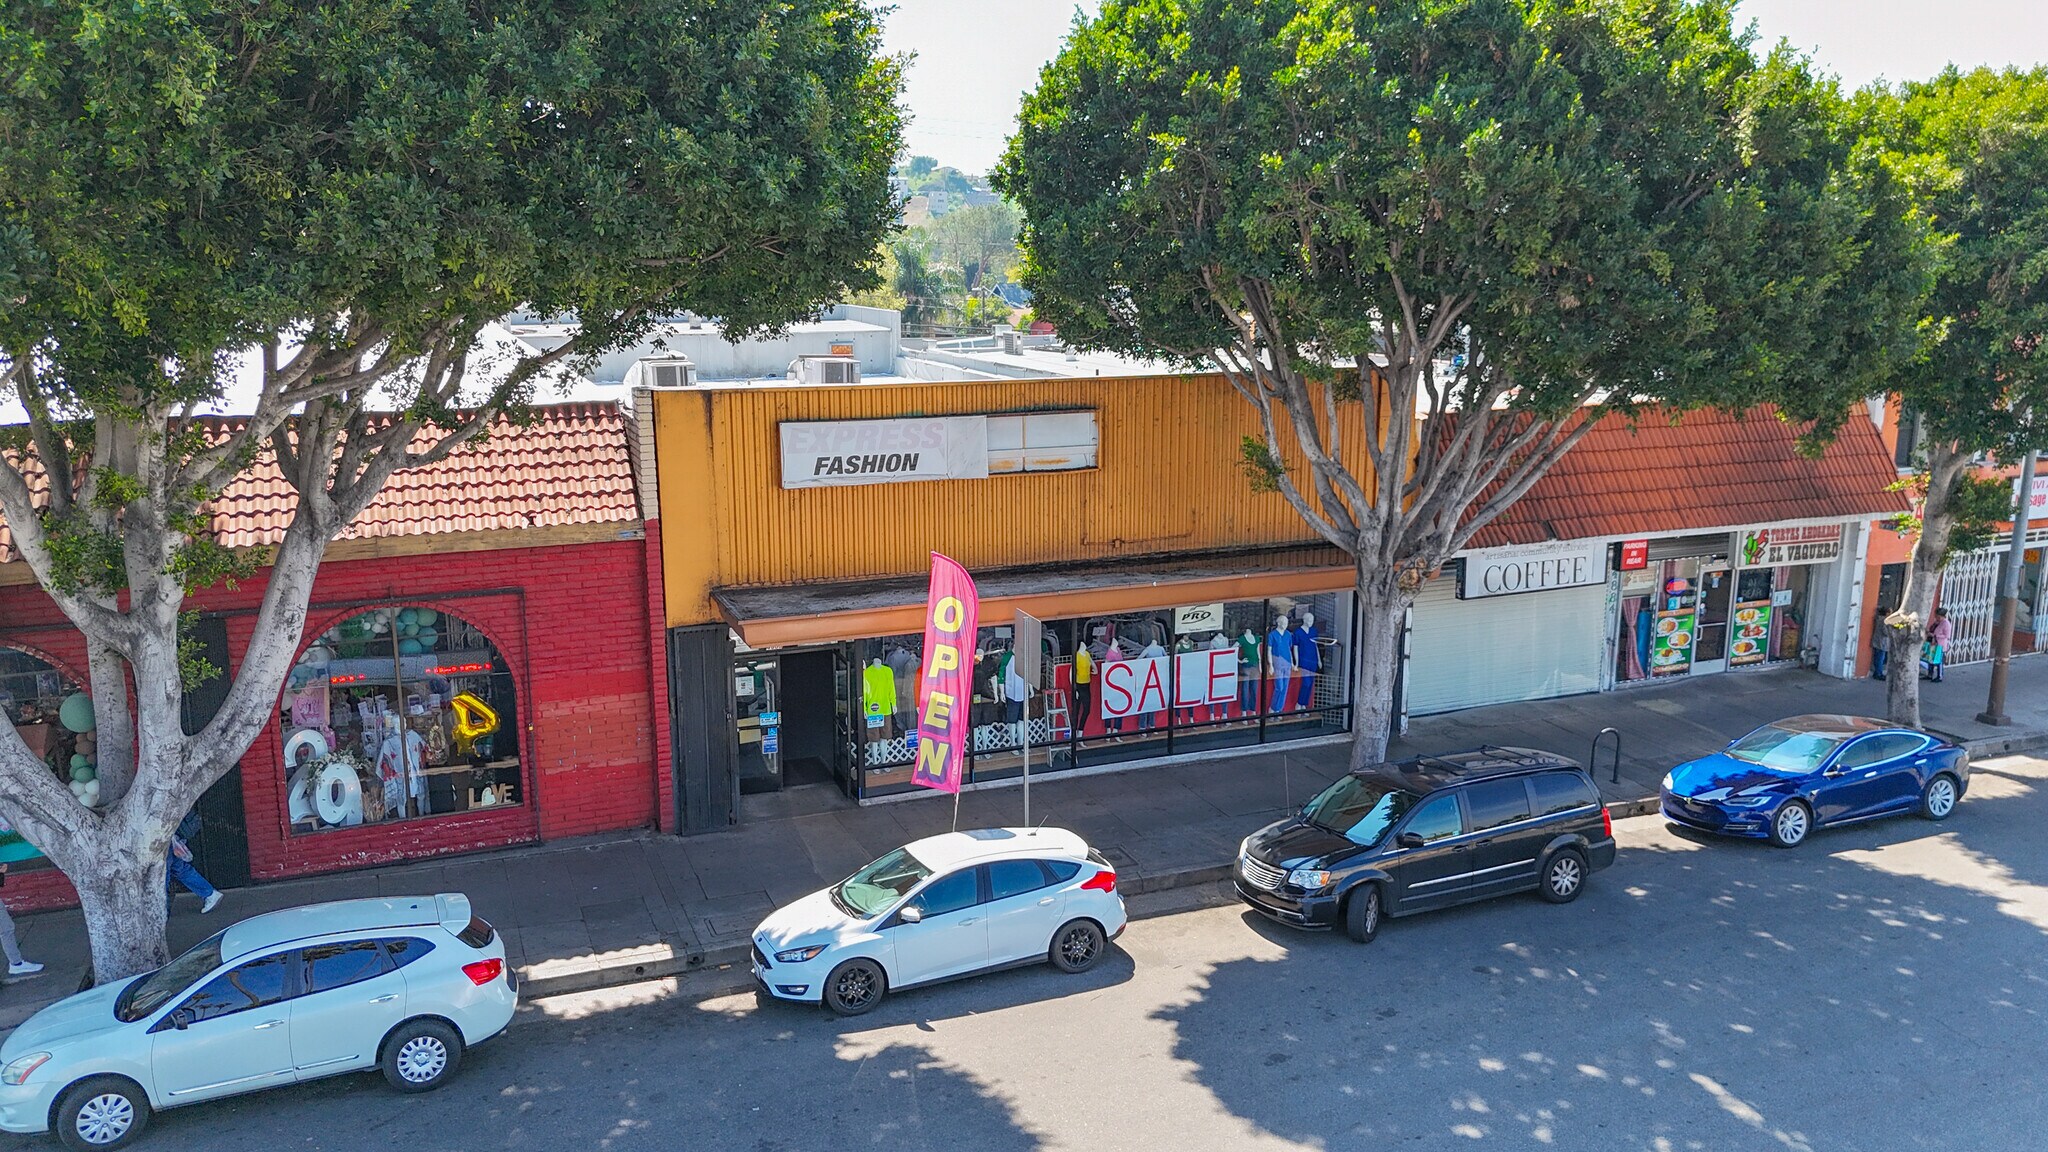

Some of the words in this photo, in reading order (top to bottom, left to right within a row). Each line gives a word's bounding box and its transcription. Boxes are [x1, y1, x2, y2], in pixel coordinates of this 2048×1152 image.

[786, 422, 945, 455] EXPRESS
[813, 452, 920, 476] FASHION
[1770, 527, 1800, 542] TORTAS
[1801, 525, 1841, 540] AHOGADAS
[1768, 546, 1783, 562] EL
[1787, 542, 1839, 561] VAQUERO
[1483, 556, 1587, 593] COFFEE
[1181, 611, 1212, 621] PRO
[918, 596, 964, 780] OPEN
[1103, 649, 1237, 714] SALE
